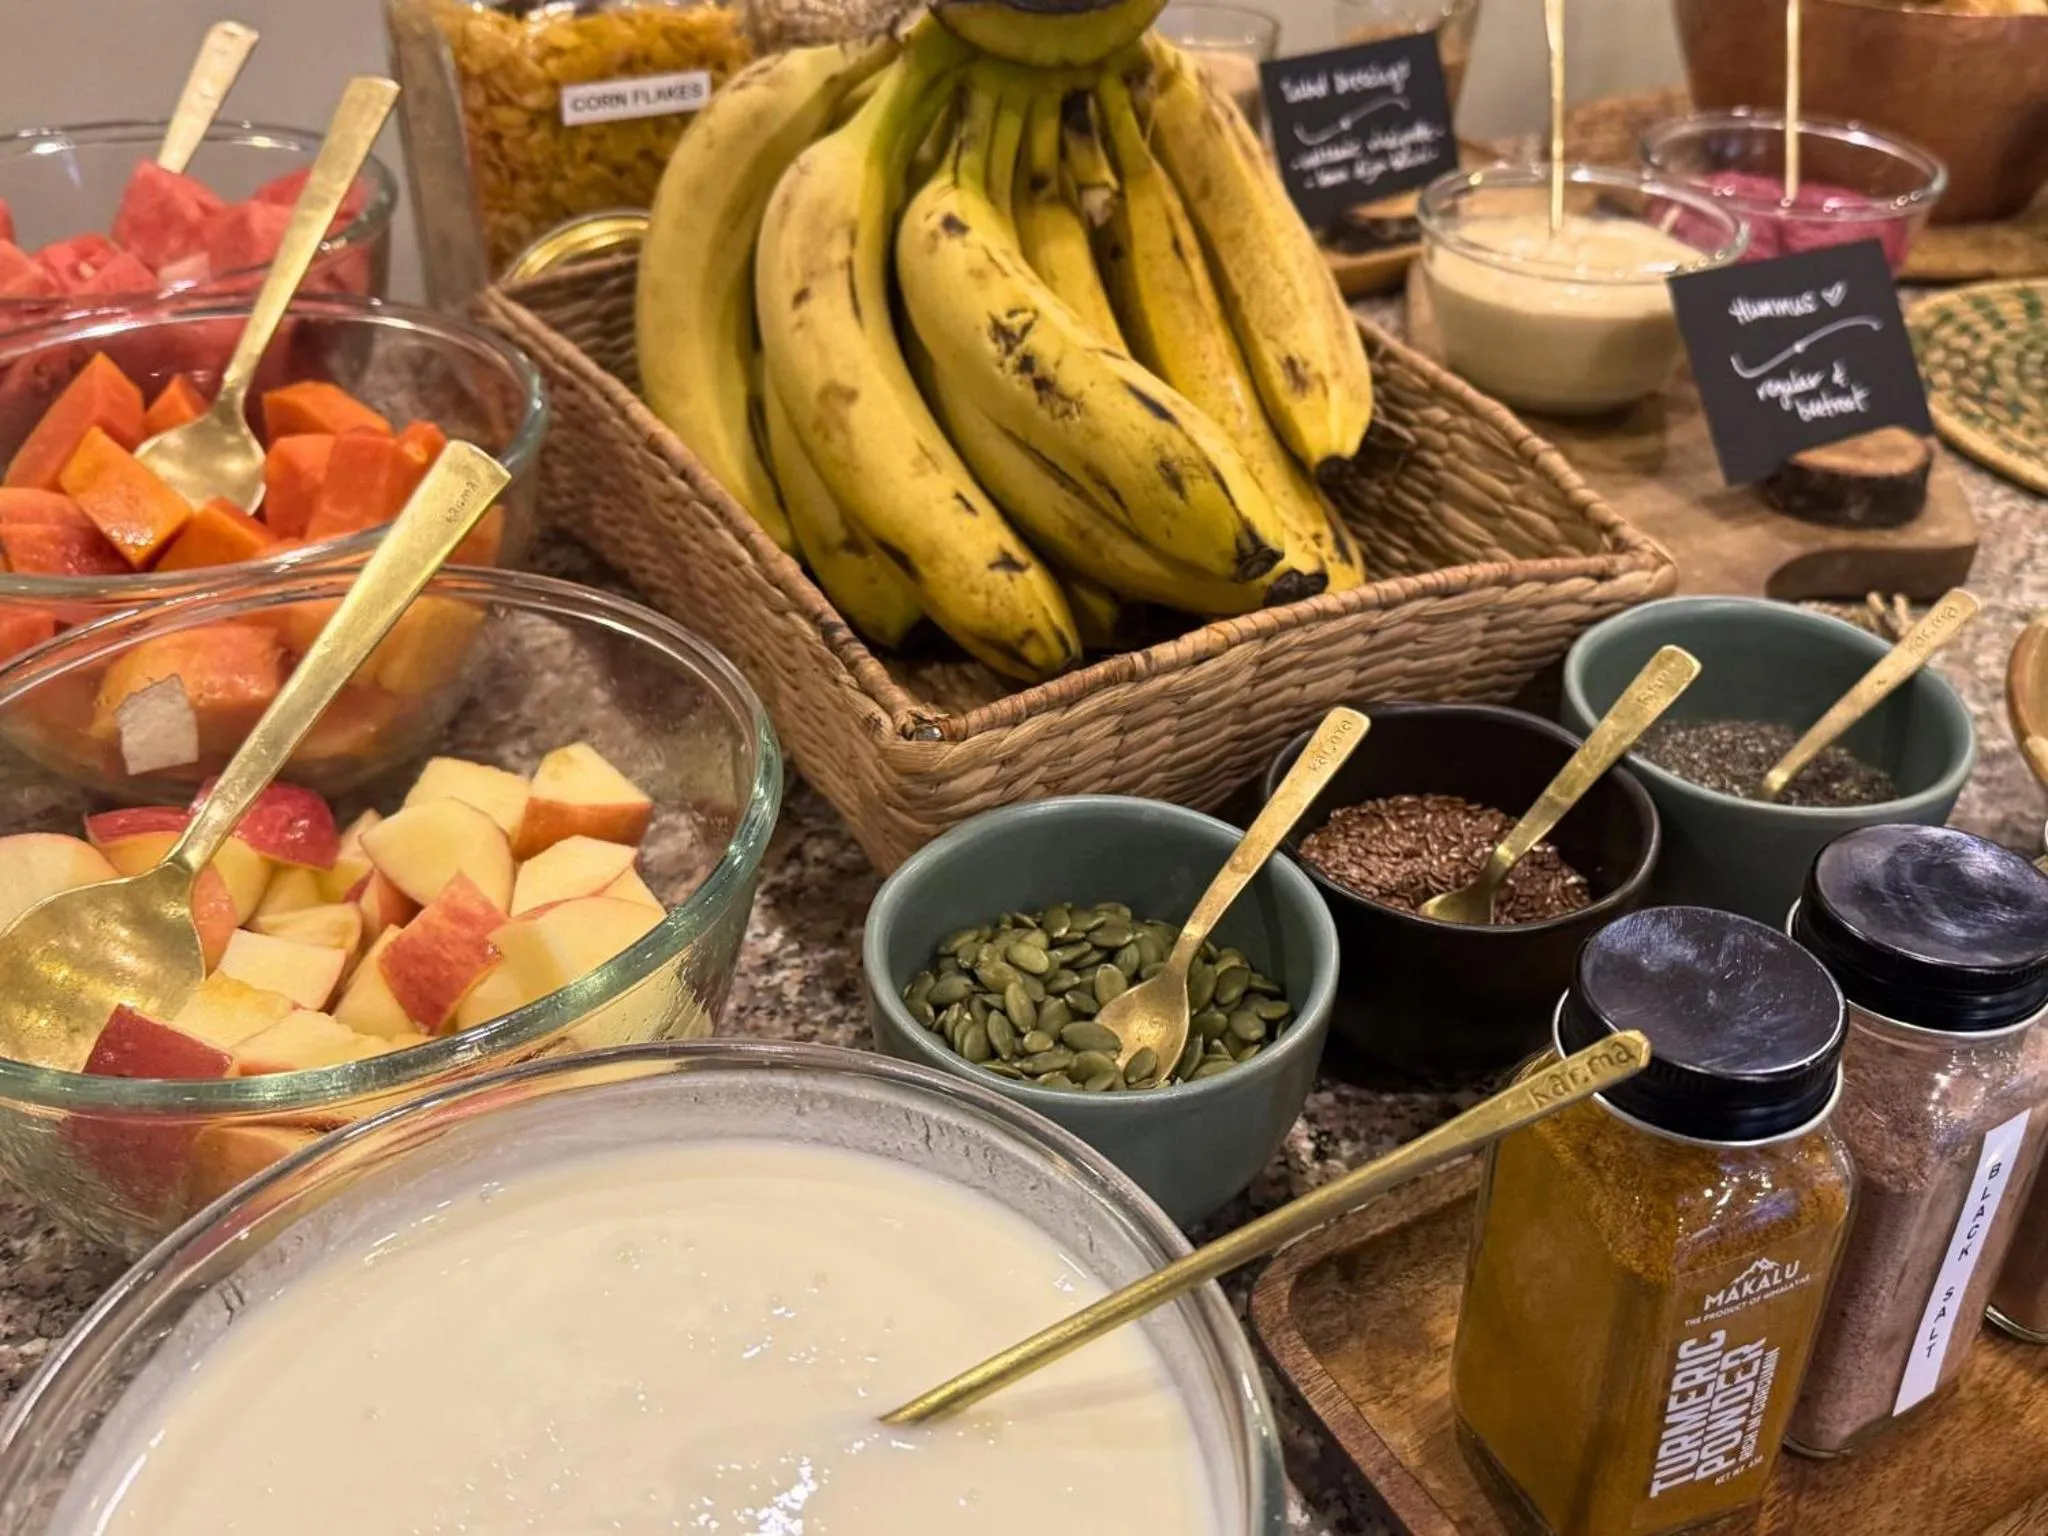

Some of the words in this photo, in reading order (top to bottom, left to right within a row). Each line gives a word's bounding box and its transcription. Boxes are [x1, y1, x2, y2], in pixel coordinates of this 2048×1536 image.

[572, 91, 628, 113] CORN
[633, 82, 704, 107] FLAKES
[1727, 289, 1819, 326] Hummus
[1958, 1162, 2003, 1262] BLACK
[1703, 1259, 1801, 1311] MAKALU
[1703, 1301, 1746, 1321] PRODUCT
[1926, 1285, 1955, 1359] SALT
[1649, 1329, 1727, 1499] TURMERIC
[1695, 1336, 1768, 1482] POWDER
